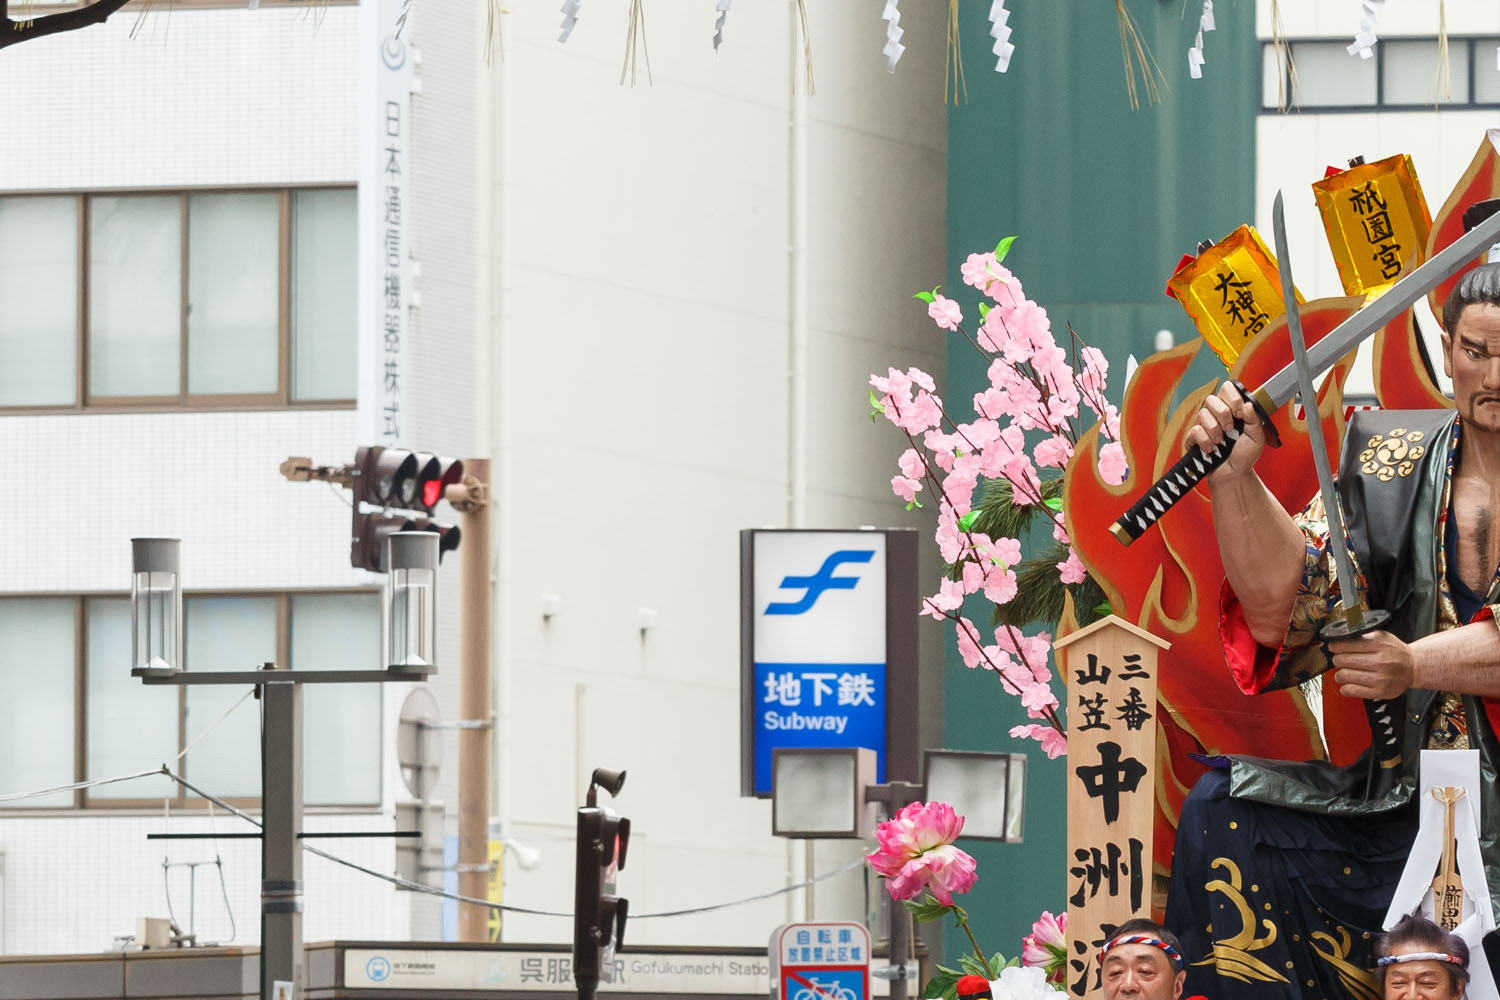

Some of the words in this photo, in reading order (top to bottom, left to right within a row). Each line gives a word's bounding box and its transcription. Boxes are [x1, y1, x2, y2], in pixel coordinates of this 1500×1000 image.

[384, 100, 401, 440] 日本通信機器株式
[763, 671, 876, 707] 地下鉄
[1074, 653, 1112, 732] 山笠
[1115, 653, 1153, 732] 三番
[763, 710, 848, 735] Subway
[796, 929, 852, 945] 自転車
[519, 957, 626, 985] 呉服駅
[631, 960, 724, 976] Gofukumachi
[728, 961, 769, 976] Statio
